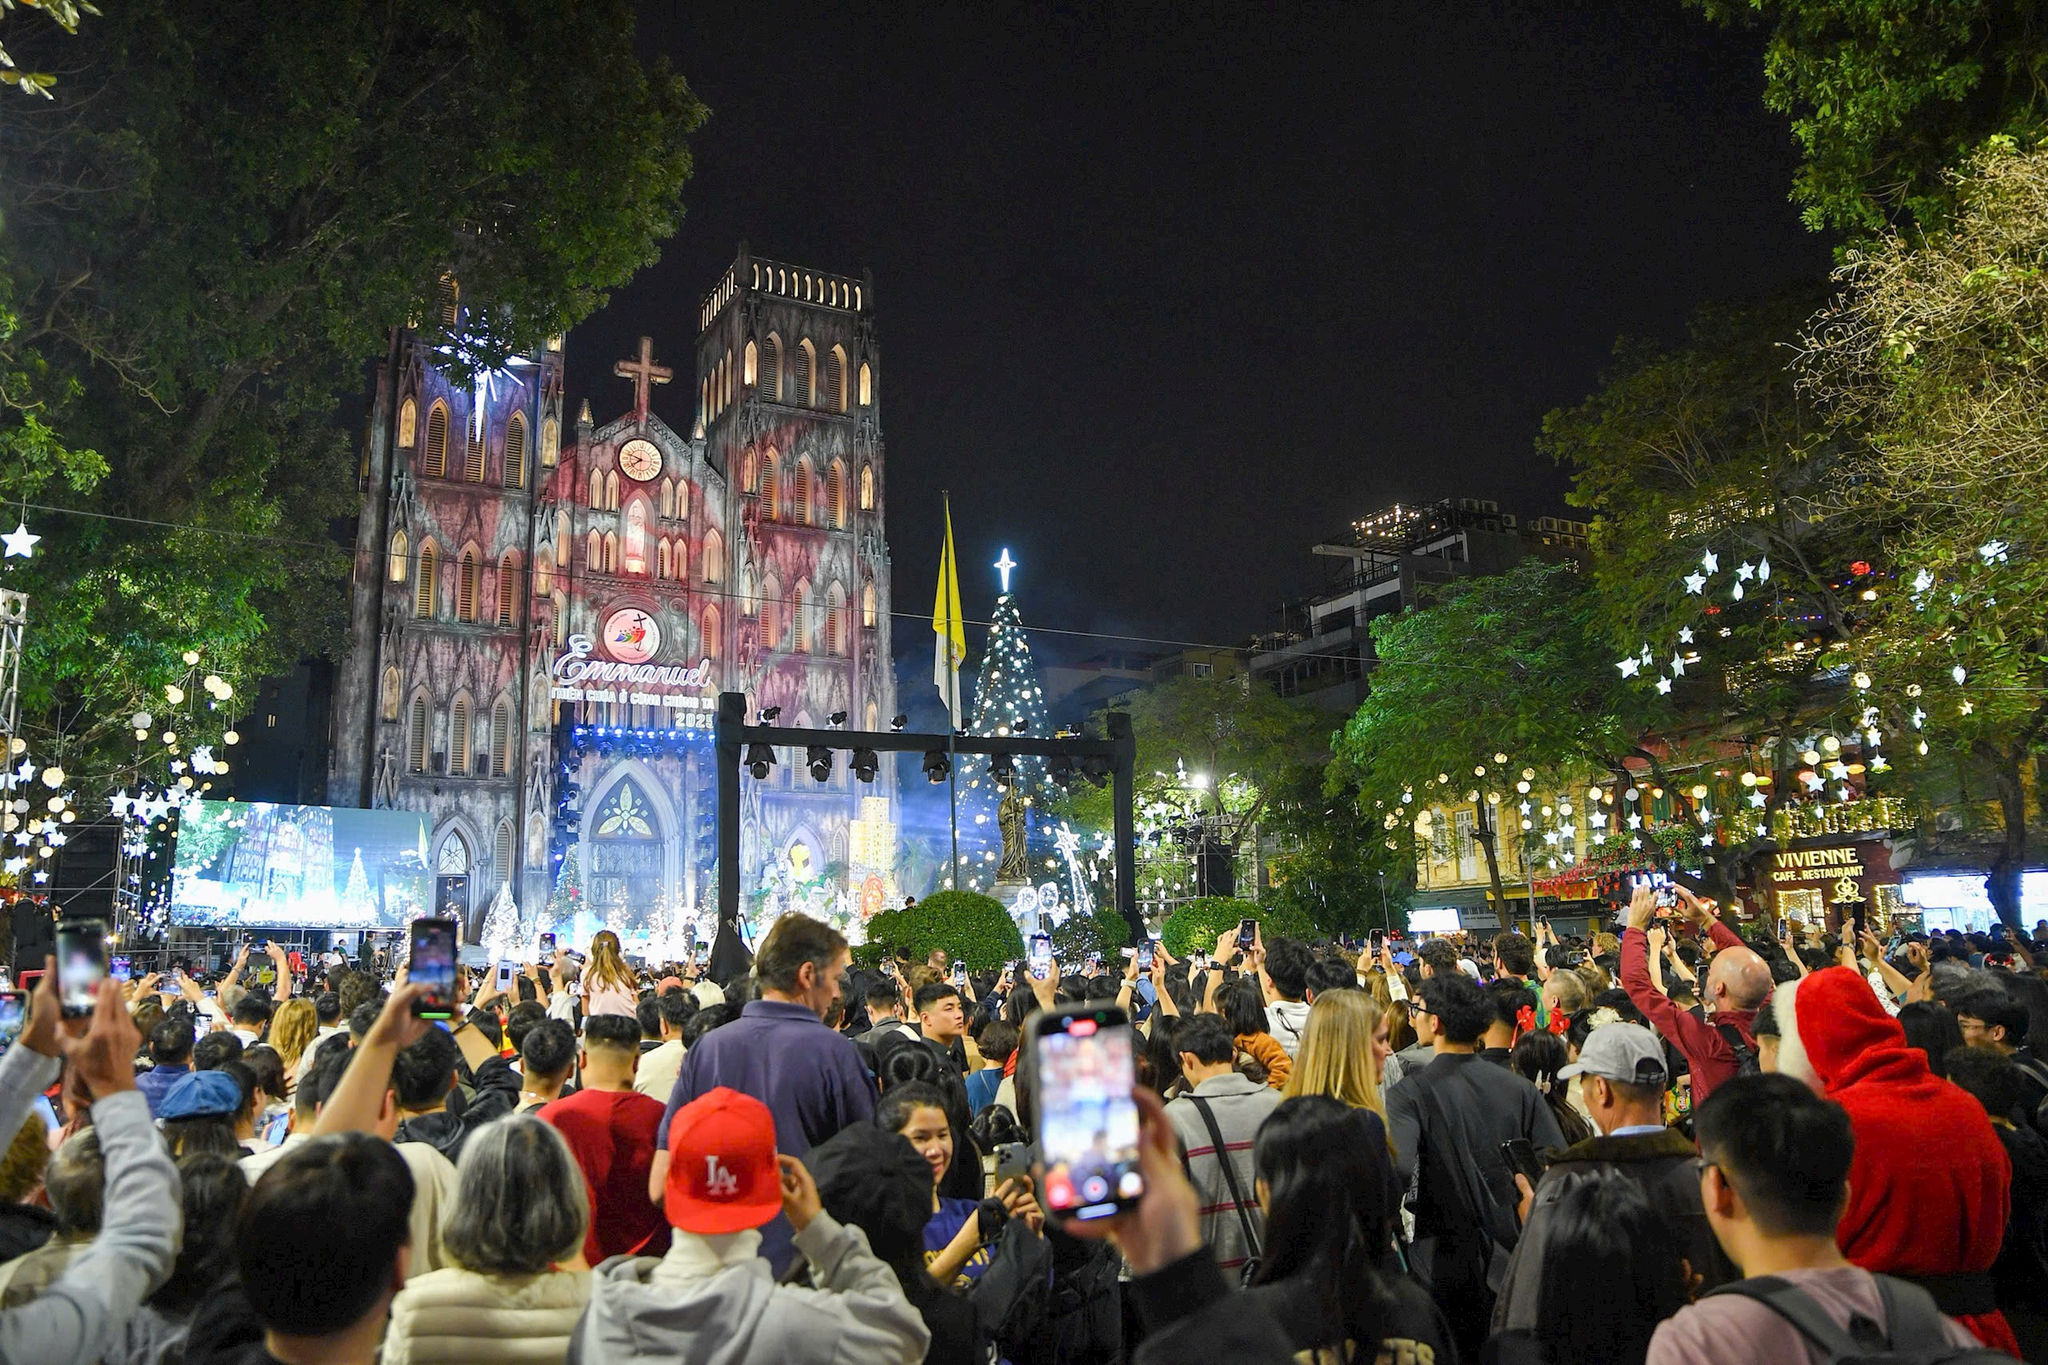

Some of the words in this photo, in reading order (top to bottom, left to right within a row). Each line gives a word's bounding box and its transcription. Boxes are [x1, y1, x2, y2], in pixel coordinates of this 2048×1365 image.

[554, 634, 712, 688] Emmanuel
[675, 712, 714, 729] 2025
[1776, 847, 1859, 869] VIVIENNE
[1773, 870, 1797, 882] CAFE
[1803, 865, 1865, 881] RESTAURANT
[705, 1154, 739, 1196] LA
